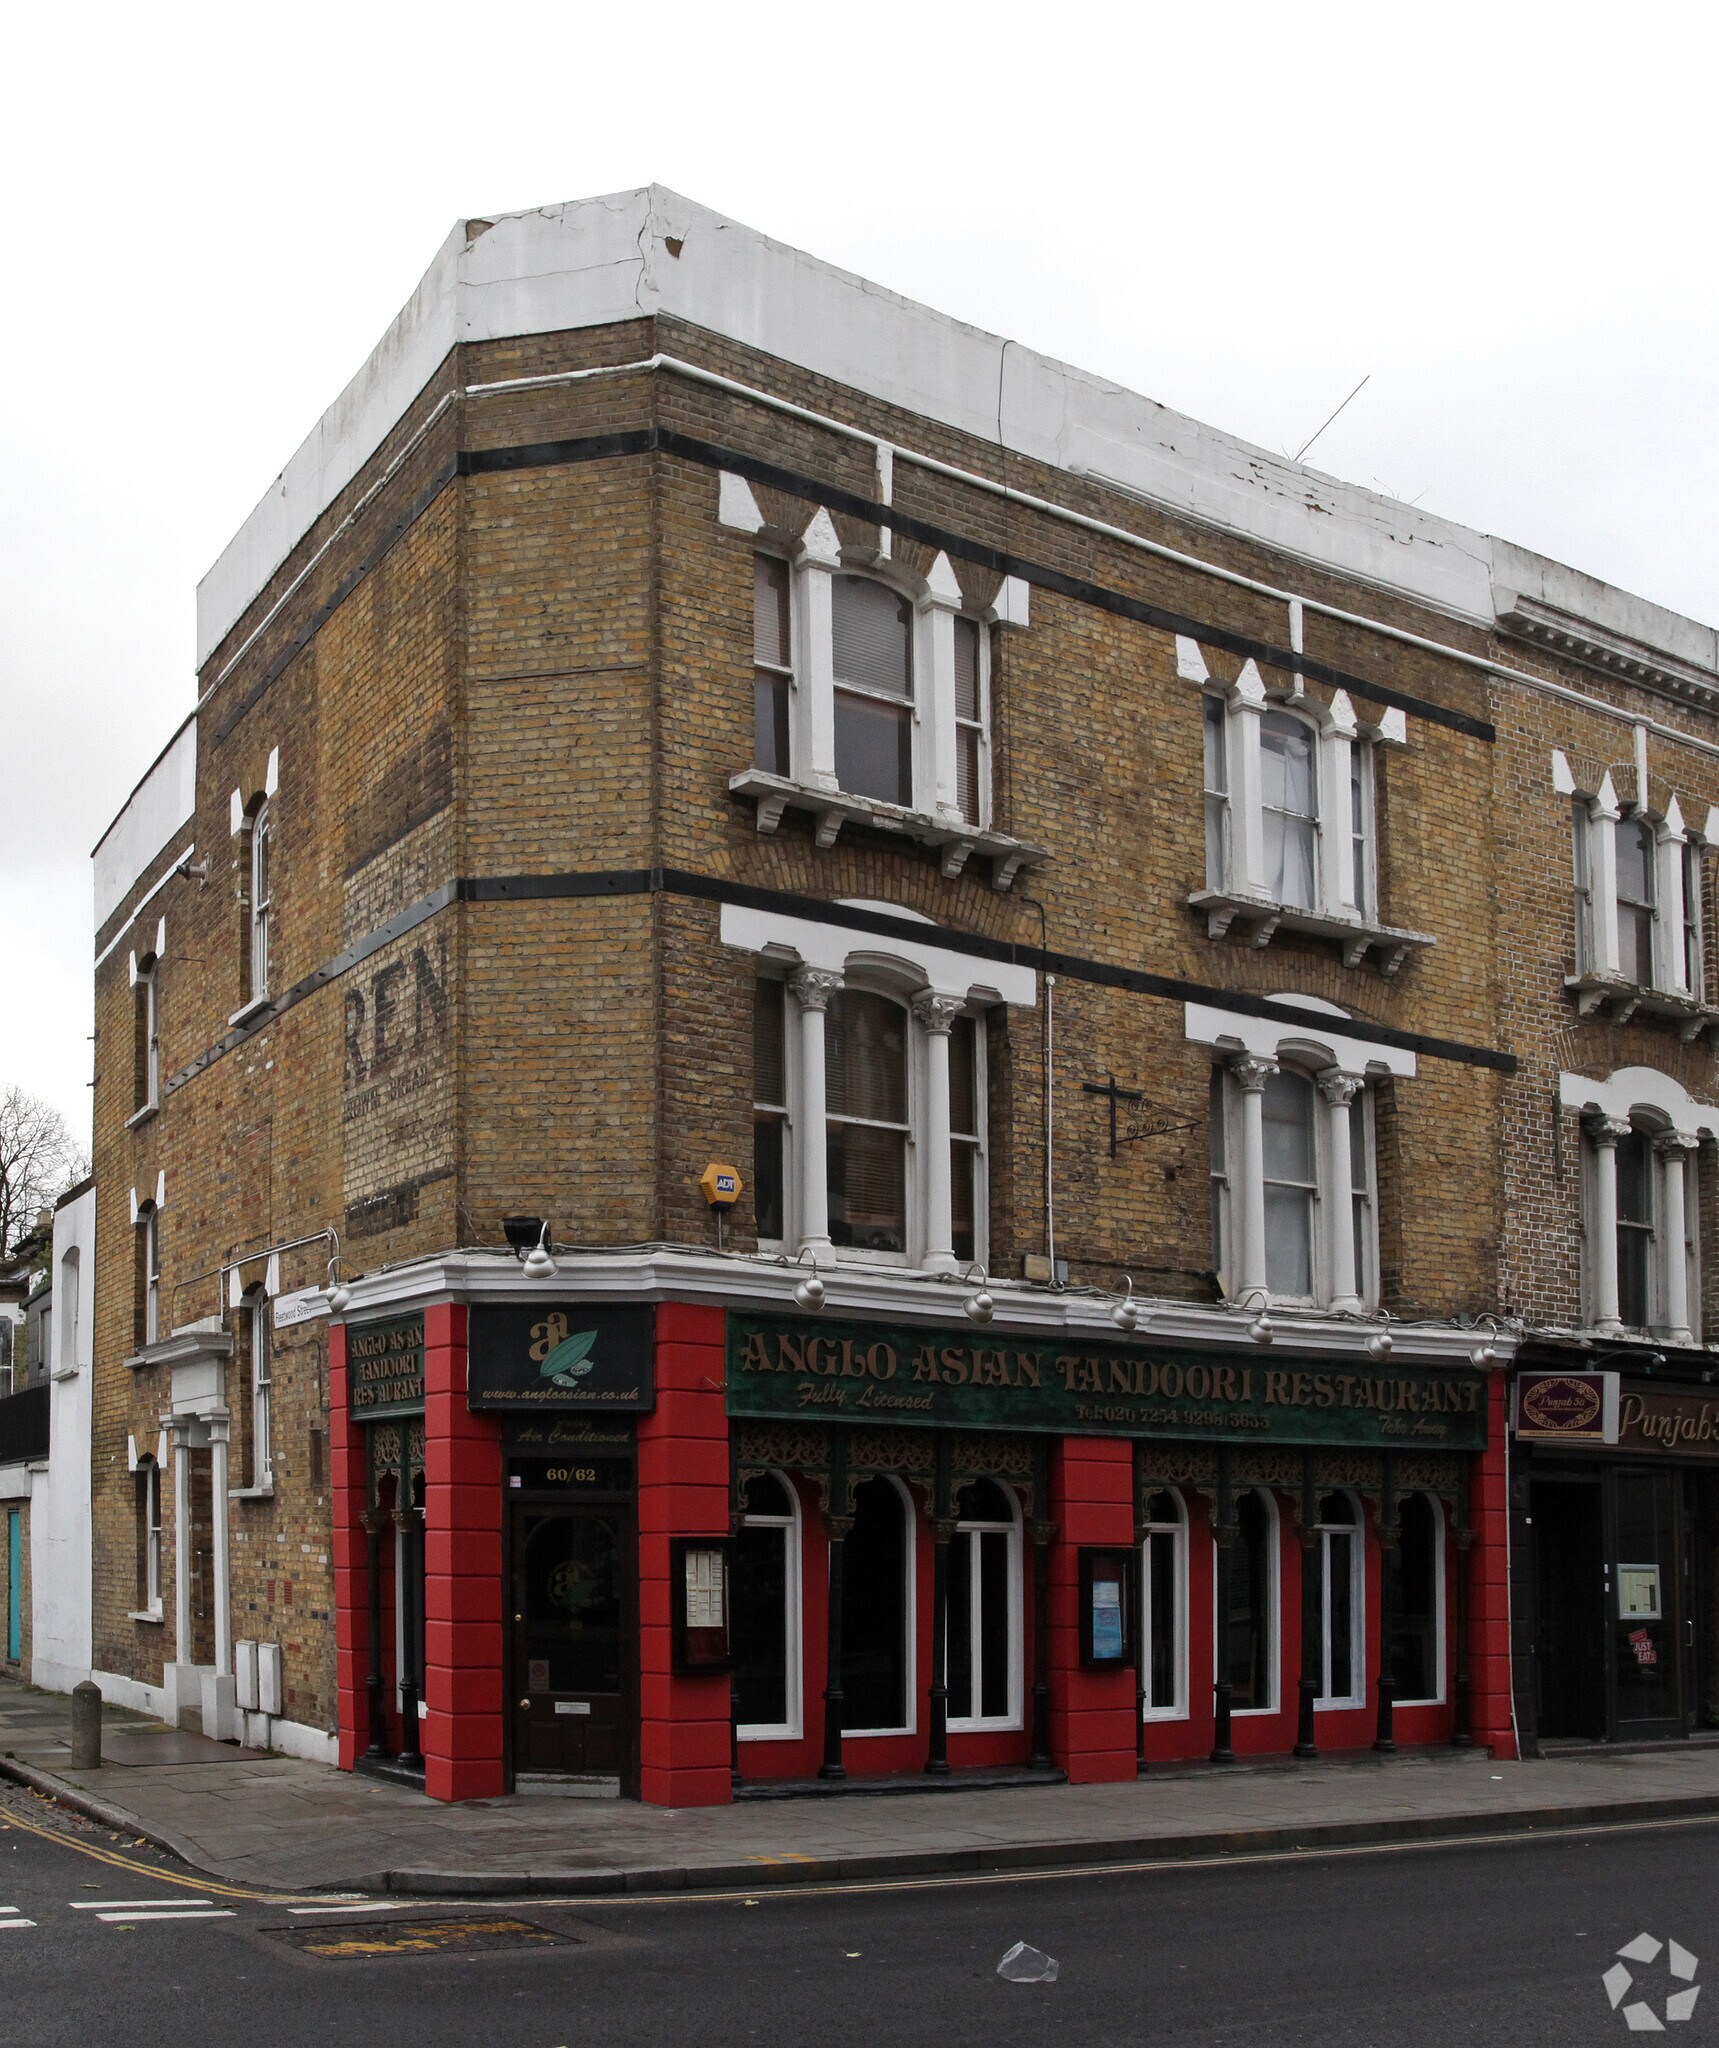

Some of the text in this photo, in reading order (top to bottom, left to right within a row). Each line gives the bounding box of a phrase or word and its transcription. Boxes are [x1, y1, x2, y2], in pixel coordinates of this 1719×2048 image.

[717, 1178, 735, 1190] ADT
[351, 1325, 424, 1358] ANGLO ASAN
[360, 1354, 416, 1381] TANDOORI
[741, 1332, 1481, 1413] ANGLO ASIAN TANDOORI RESTAURANT
[353, 1377, 423, 1406] RESAURANT
[482, 1387, 640, 1403] www.angloasian.co.uk
[796, 1382, 936, 1411] Fully Licensed
[1538, 1395, 1572, 1409] Punjab
[1140, 1408, 1179, 1425] 7254
[1378, 1414, 1447, 1440] Take Away
[1618, 1393, 1710, 1447] Punjab
[517, 1427, 631, 1445] Air Conditioned
[546, 1467, 596, 1482] 60/62
[1634, 1641, 1651, 1651] JUST
